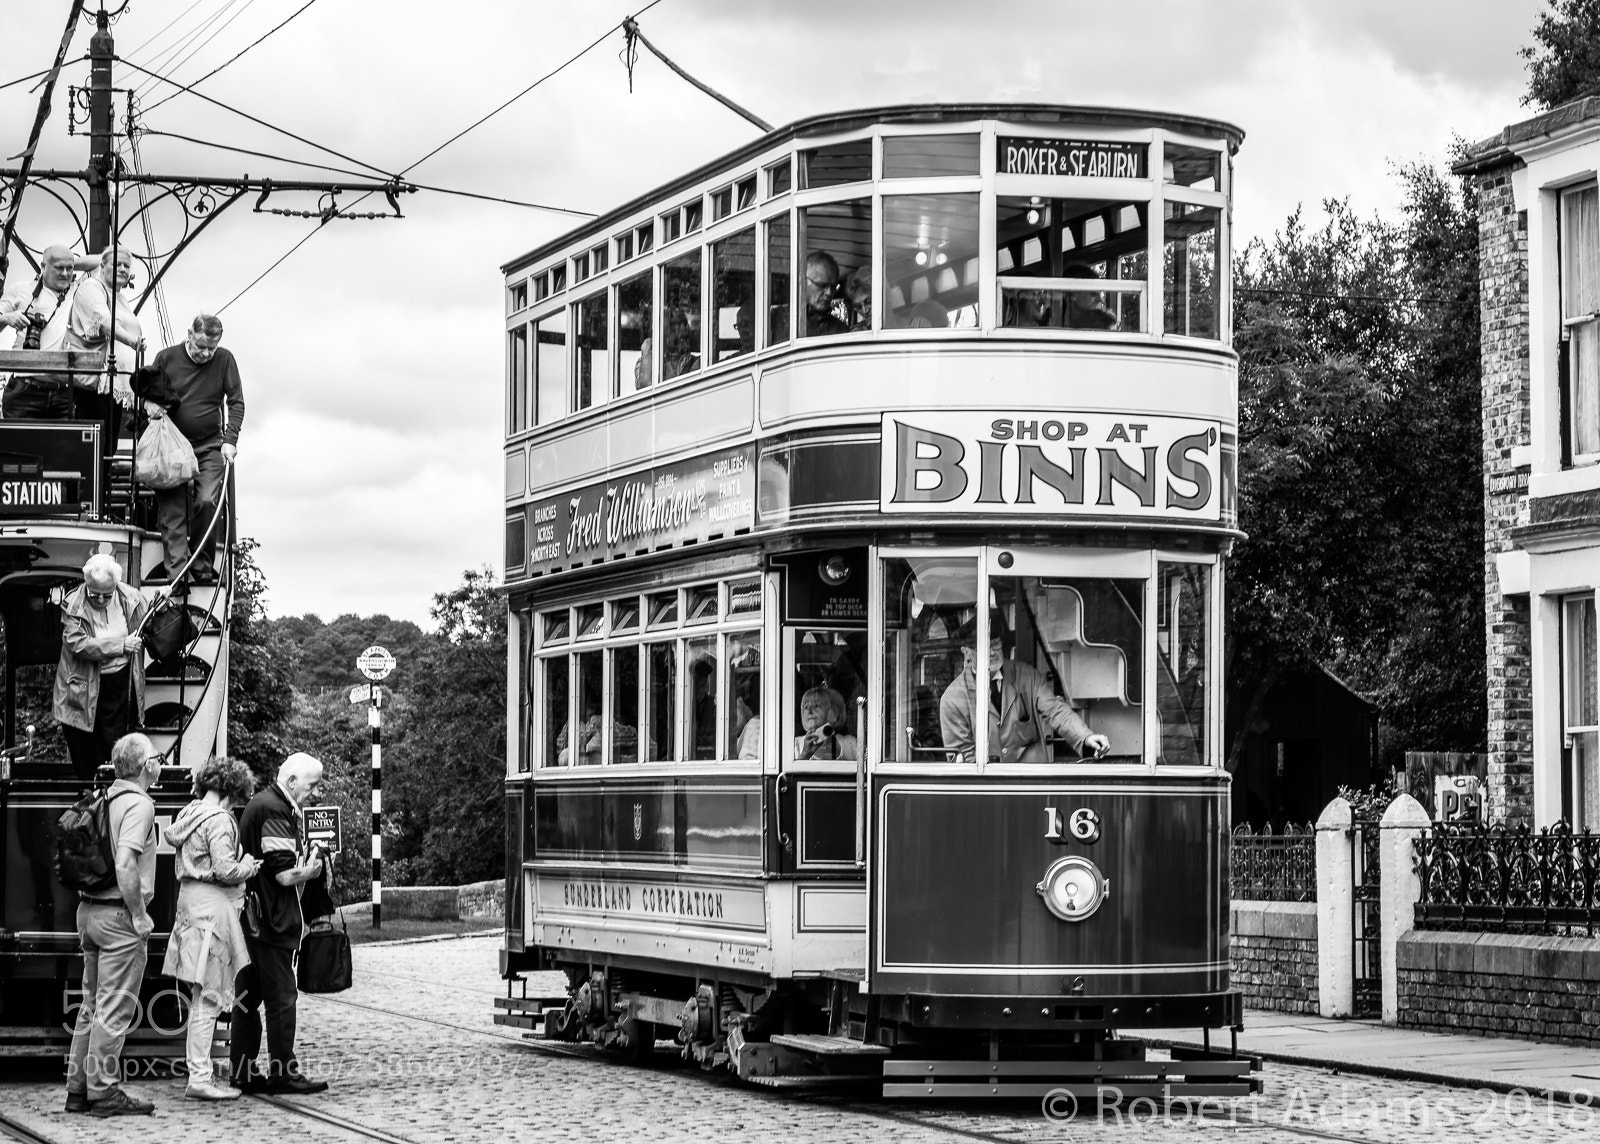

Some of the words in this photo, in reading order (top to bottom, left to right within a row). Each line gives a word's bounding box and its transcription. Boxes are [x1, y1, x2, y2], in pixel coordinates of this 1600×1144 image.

[1008, 146, 1058, 175] ROKER
[1060, 156, 1067, 171] &
[1068, 150, 1138, 178] SEABURN
[991, 419, 1089, 441] SHOP
[1106, 423, 1148, 444] AT
[713, 455, 744, 479] SUPPLIERS
[2, 482, 62, 505] STATION
[719, 480, 736, 499] PAINT
[534, 504, 557, 524] BRANCHES
[566, 494, 604, 556] Fred
[606, 480, 692, 545] Williamson
[537, 525, 554, 543] ACROSS
[549, 541, 560, 559] EAST
[308, 818, 334, 828] ENTRY
[314, 811, 328, 820] NO
[1044, 806, 1101, 845] 16
[564, 883, 632, 911] SUNDERLAND
[642, 887, 724, 919] CORPORATION
